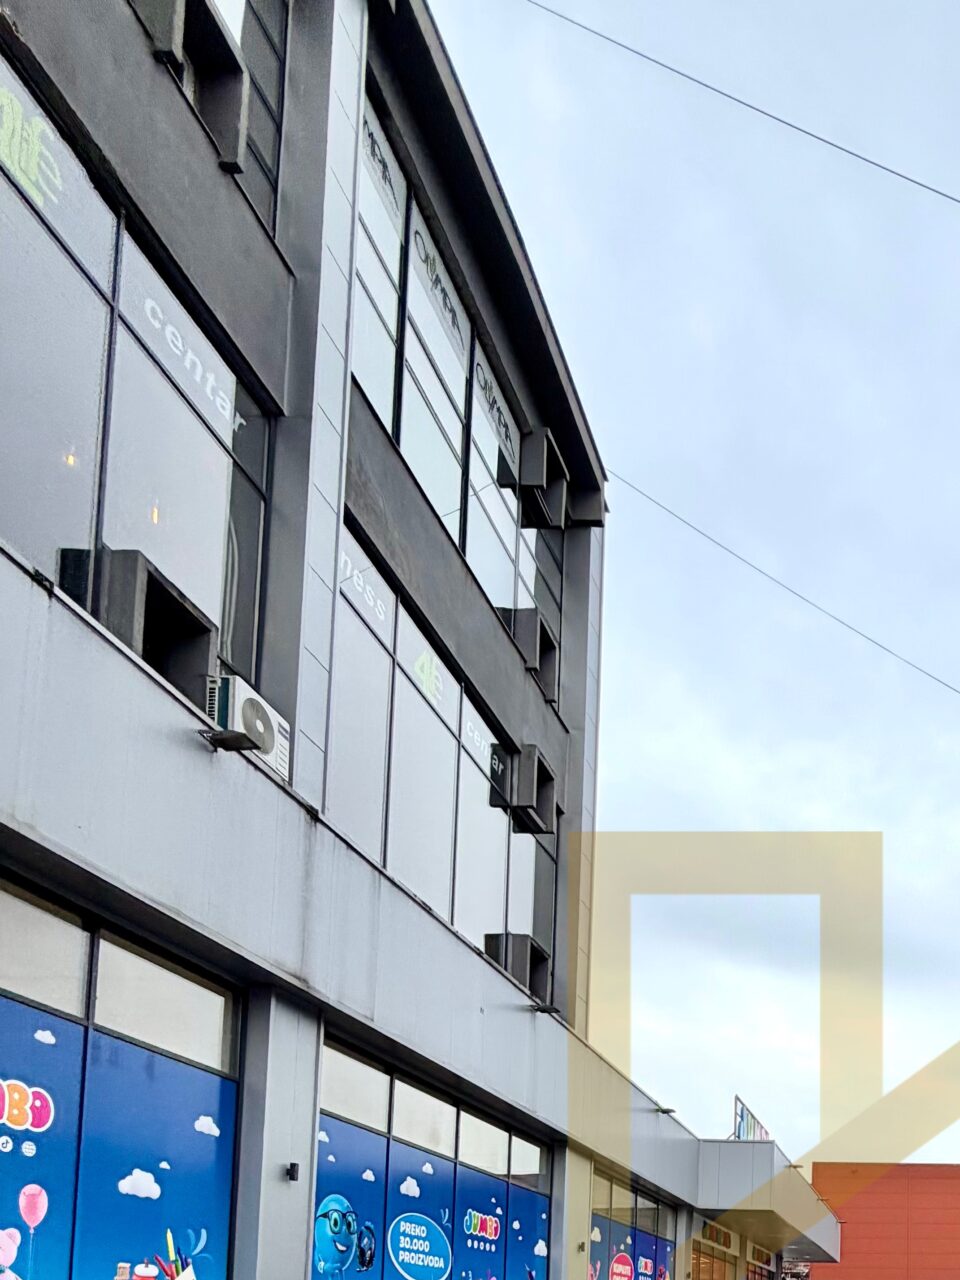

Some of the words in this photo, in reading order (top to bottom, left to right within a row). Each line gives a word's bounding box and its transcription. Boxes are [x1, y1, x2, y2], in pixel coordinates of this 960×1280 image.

[144, 298, 247, 432] centar
[0, 1079, 55, 1133] BO
[400, 1221, 427, 1238] PREKO
[463, 1208, 501, 1240] JUMBO
[399, 1236, 430, 1252] 30.000
[399, 1250, 445, 1269] PROIZVODA
